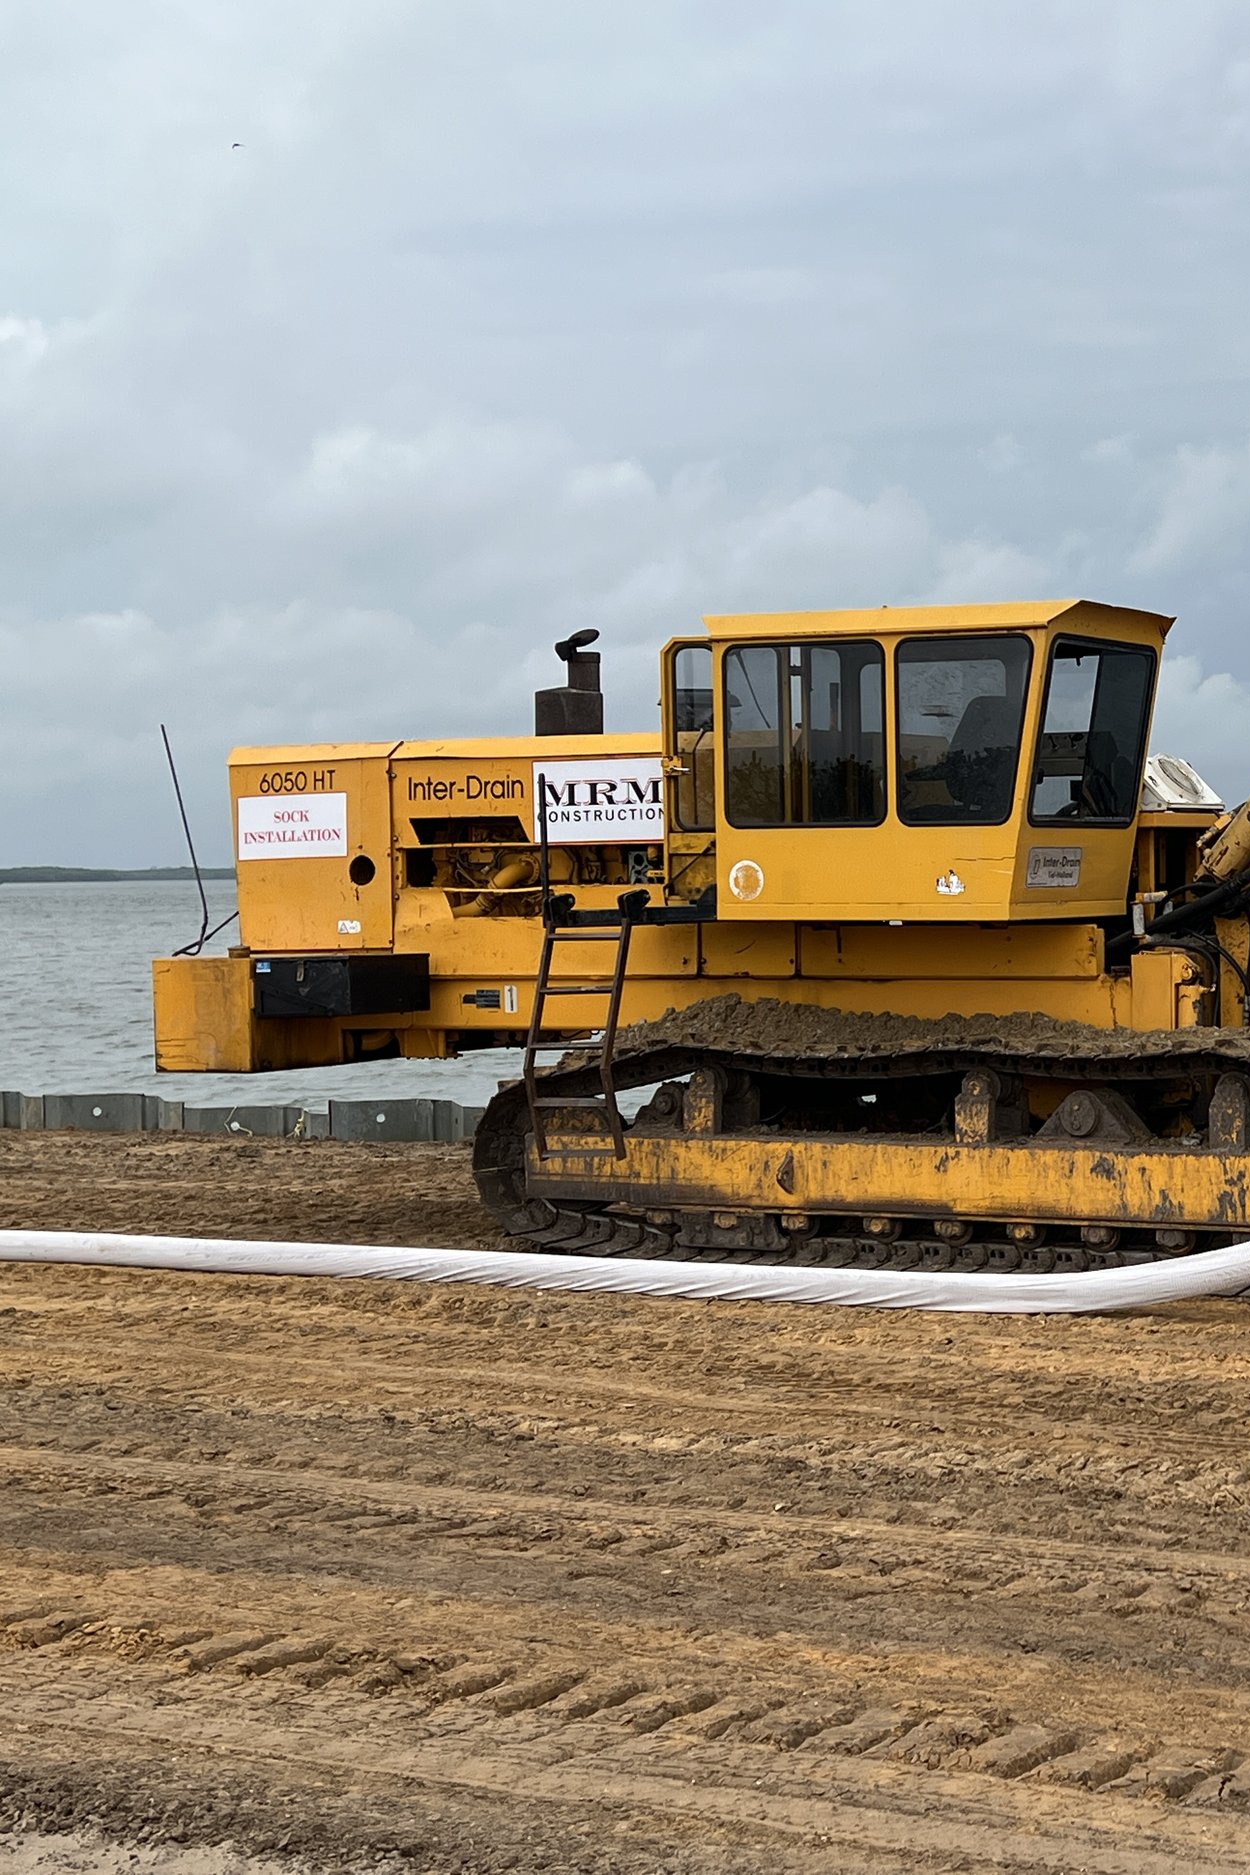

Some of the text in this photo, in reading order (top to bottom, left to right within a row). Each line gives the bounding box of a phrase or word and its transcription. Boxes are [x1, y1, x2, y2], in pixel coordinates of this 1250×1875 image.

[260, 769, 336, 793] 6050 HT
[408, 774, 524, 801] Inter-Drain
[539, 777, 663, 807] MRM
[273, 809, 310, 824] SOCK
[243, 828, 342, 845] INSTALLATION
